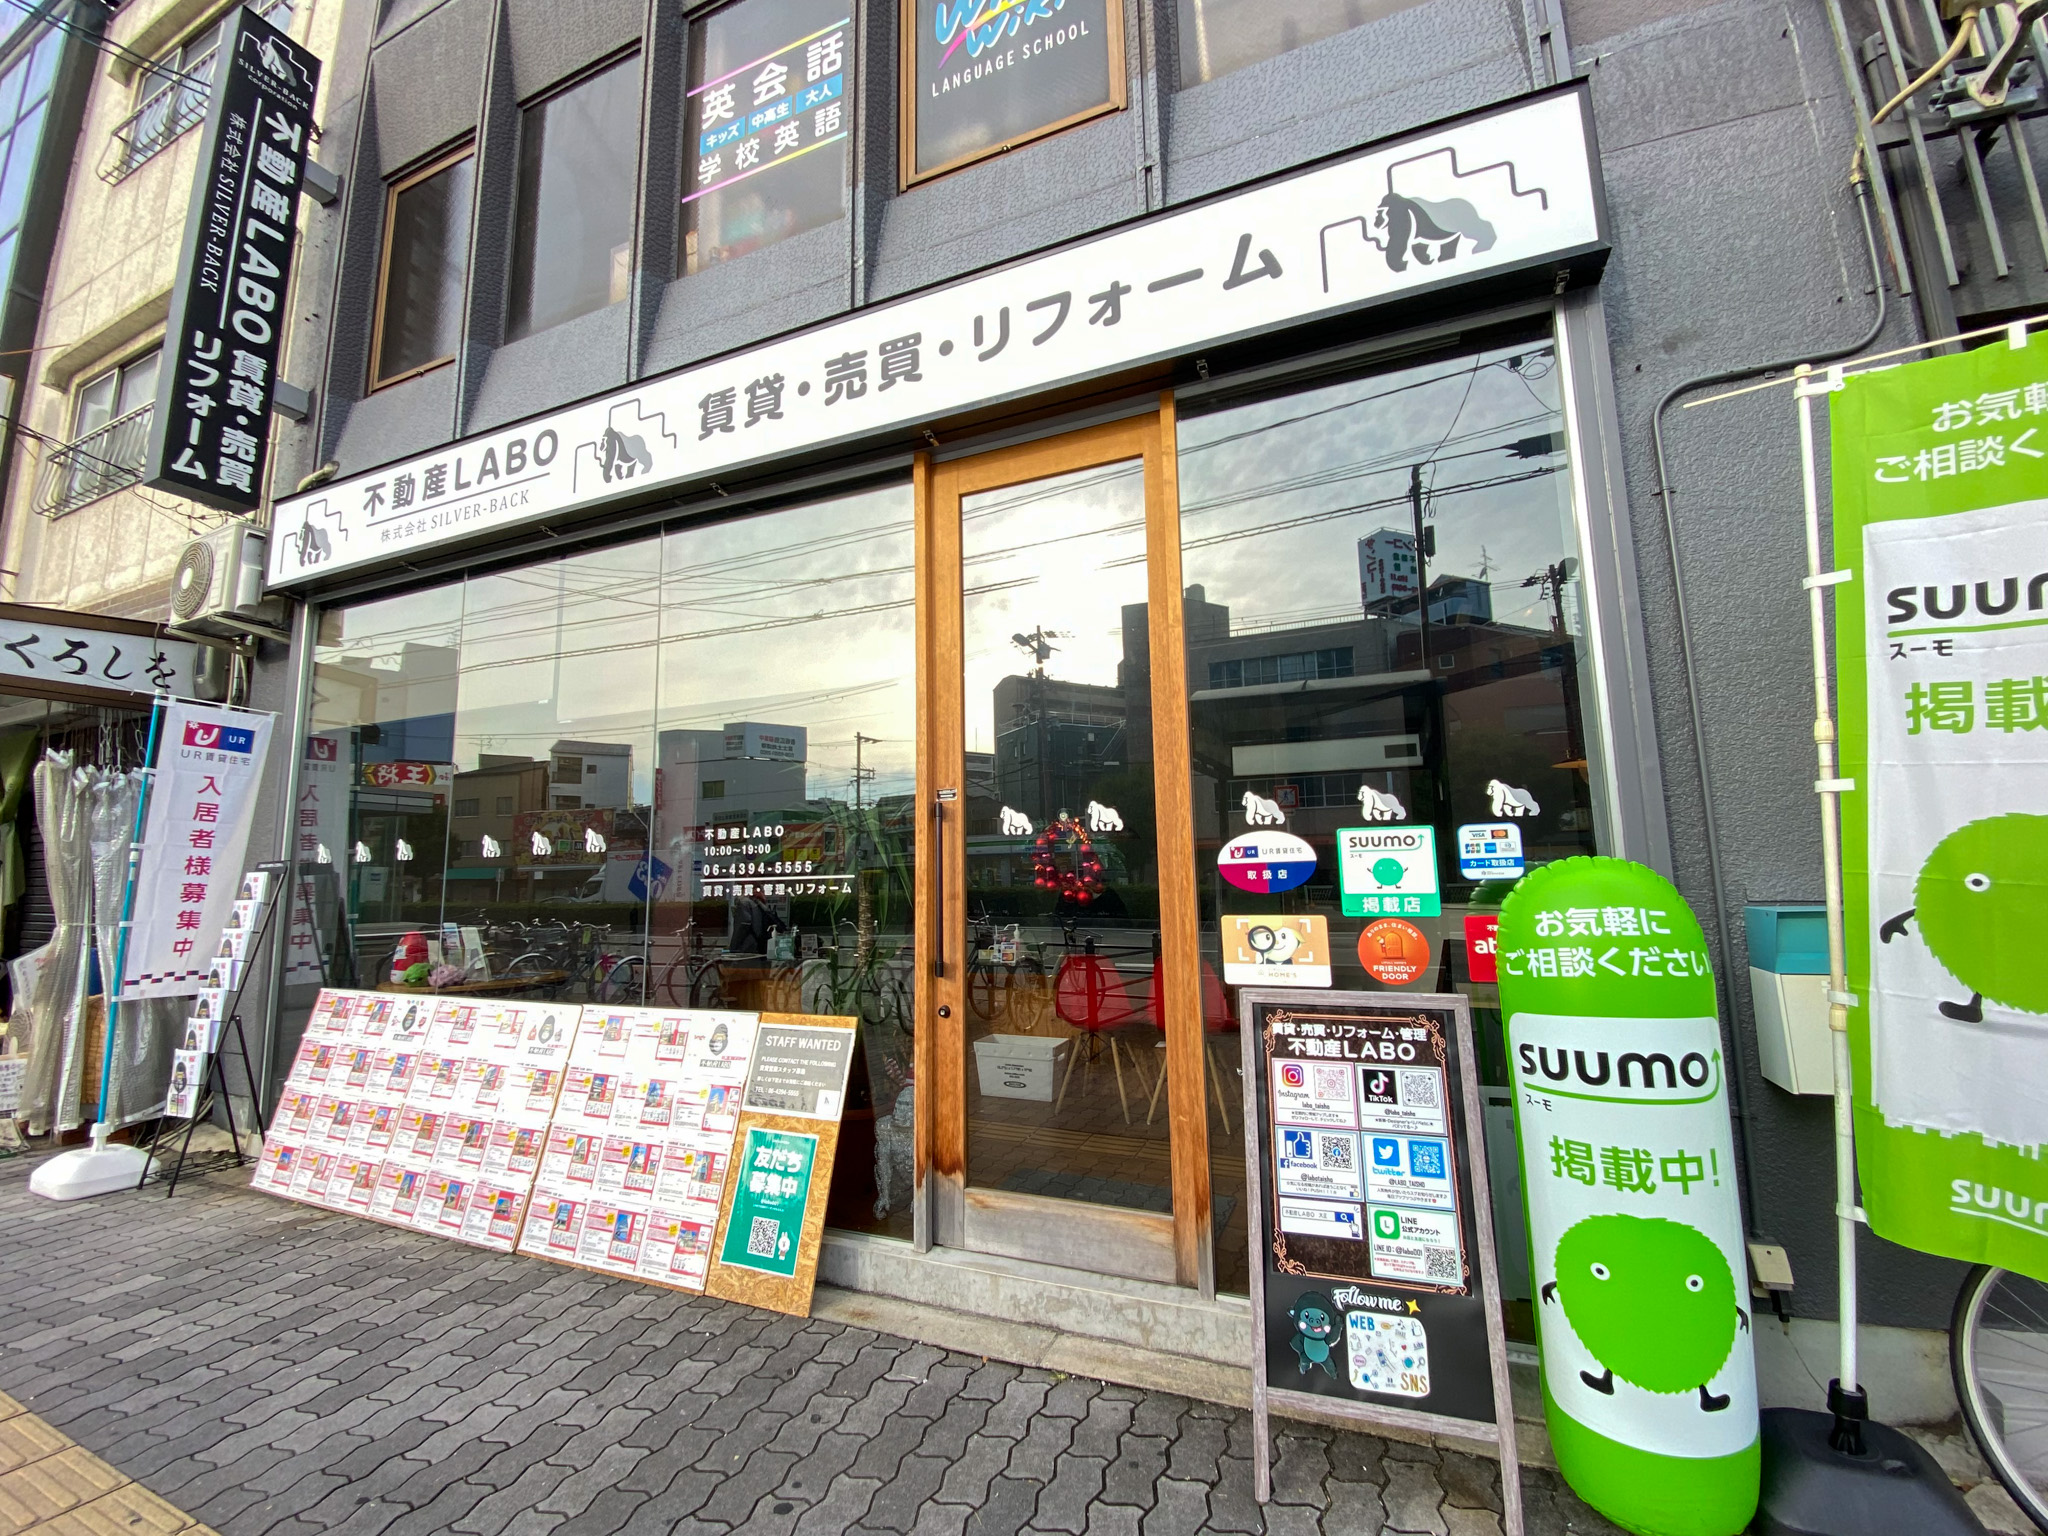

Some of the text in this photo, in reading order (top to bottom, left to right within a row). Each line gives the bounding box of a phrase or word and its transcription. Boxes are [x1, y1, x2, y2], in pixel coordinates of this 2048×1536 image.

[932, 50, 1015, 98] LANGUAGE
[1022, 20, 1090, 60] SCHOOL
[238, 57, 309, 110] SILVER-BACK
[248, 74, 298, 110] corporation
[702, 31, 844, 130] 英会話
[805, 84, 833, 106] 大人
[751, 102, 790, 128] 中高生
[698, 102, 842, 185] 学校英語
[706, 123, 740, 148] キッズ
[200, 112, 248, 294] 株式会社 SILVER-BACK
[216, 112, 302, 494] 不動産LABO 賃貸・売買
[697, 232, 1284, 442] 賃貸・売買・リフォーム
[171, 330, 223, 481] リフォーム
[1874, 427, 2046, 484] ご相談く
[363, 429, 559, 517] 不動産LABO
[381, 489, 530, 543] 株式会社 SILVER-BACK
[4, 633, 177, 689] くろしを
[1889, 639, 1954, 660] スーモ
[229, 735, 246, 745] UR
[180, 748, 251, 766] UR賃貸住宅
[704, 825, 785, 841] 不動産LABO
[1349, 835, 1415, 848] suumo
[172, 775, 223, 959] 入居者様募集中
[703, 861, 813, 876] 06-4394-5555
[1247, 869, 1288, 879] 取扱店
[1362, 897, 1421, 913] 掲載店
[1534, 906, 1671, 937] お気軽に
[1373, 965, 1417, 973] FRIENDLY
[1505, 946, 1711, 978] ご相談ください
[766, 1035, 841, 1051] STAFF WANTED
[1288, 1037, 1416, 1061] 不動産LABO
[1519, 1042, 1709, 1088] suumo
[1278, 1089, 1310, 1101] Instagram
[1368, 1094, 1394, 1103] TikTok
[1525, 1094, 1553, 1112] スーモ
[753, 1145, 803, 1173] 友だち
[1290, 1161, 1317, 1169] facebook
[1372, 1167, 1405, 1176] twitter
[749, 1171, 799, 1199] 募集中
[1401, 1217, 1417, 1225] LINE
[1402, 1226, 1440, 1235] 公式アカウント
[1374, 1244, 1384, 1252] LINE
[1333, 1286, 1377, 1310] Follow
[1349, 1314, 1375, 1331] WEB
[1401, 1372, 1427, 1393] SNS
